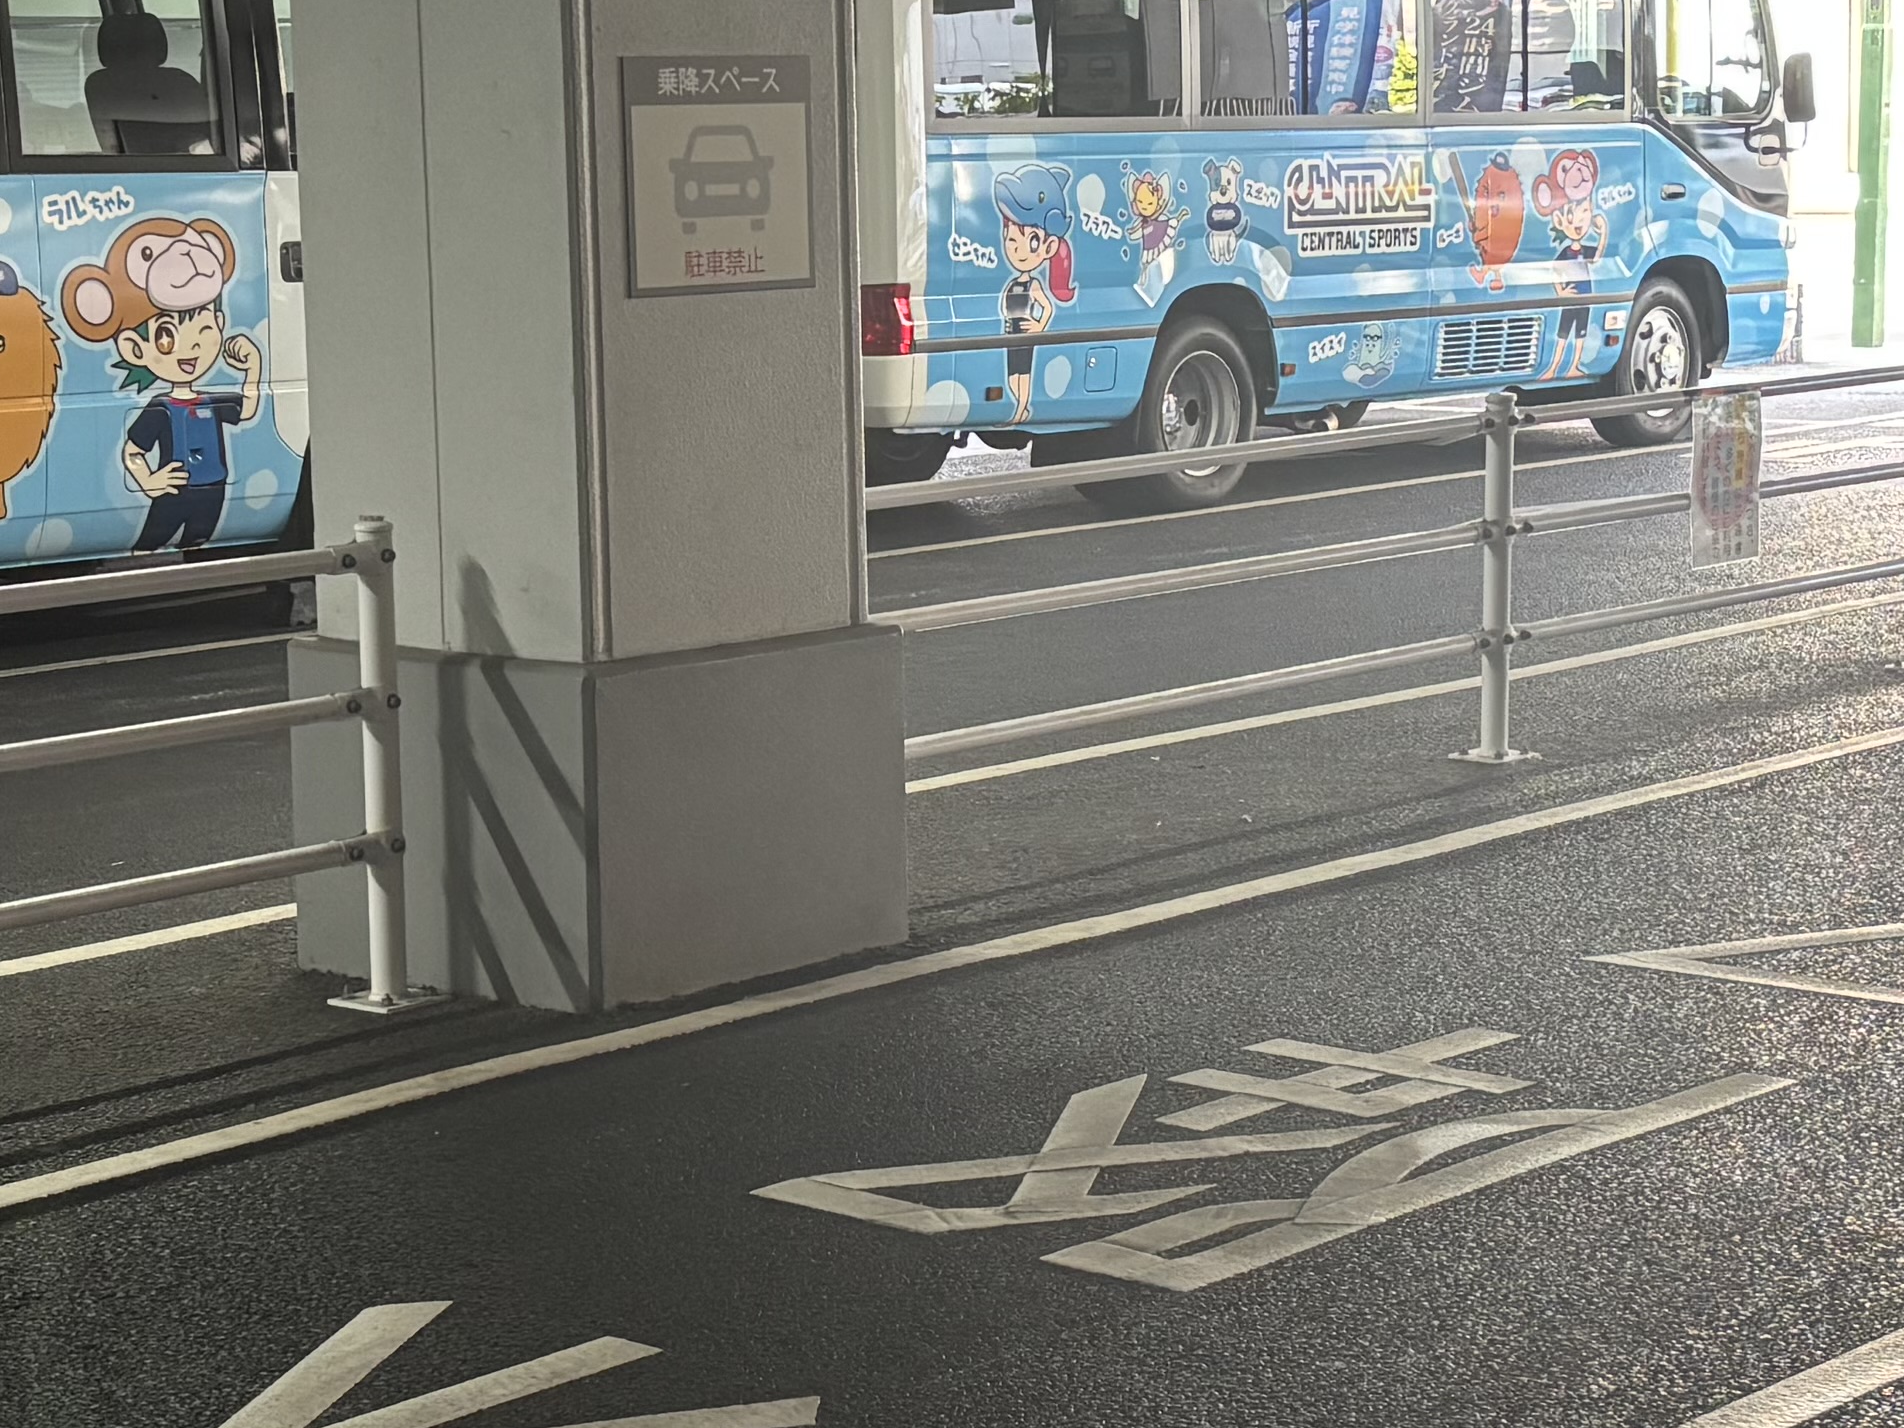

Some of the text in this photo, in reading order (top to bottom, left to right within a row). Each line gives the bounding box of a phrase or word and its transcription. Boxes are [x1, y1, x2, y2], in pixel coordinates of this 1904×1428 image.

[657, 67, 780, 96] 乗降スペース
[1287, 153, 1433, 228] CENTRAL
[46, 190, 131, 226] ラルちゃん
[1301, 228, 1419, 252] CENTRAL SPORTS
[684, 245, 766, 277] 駐車禁止
